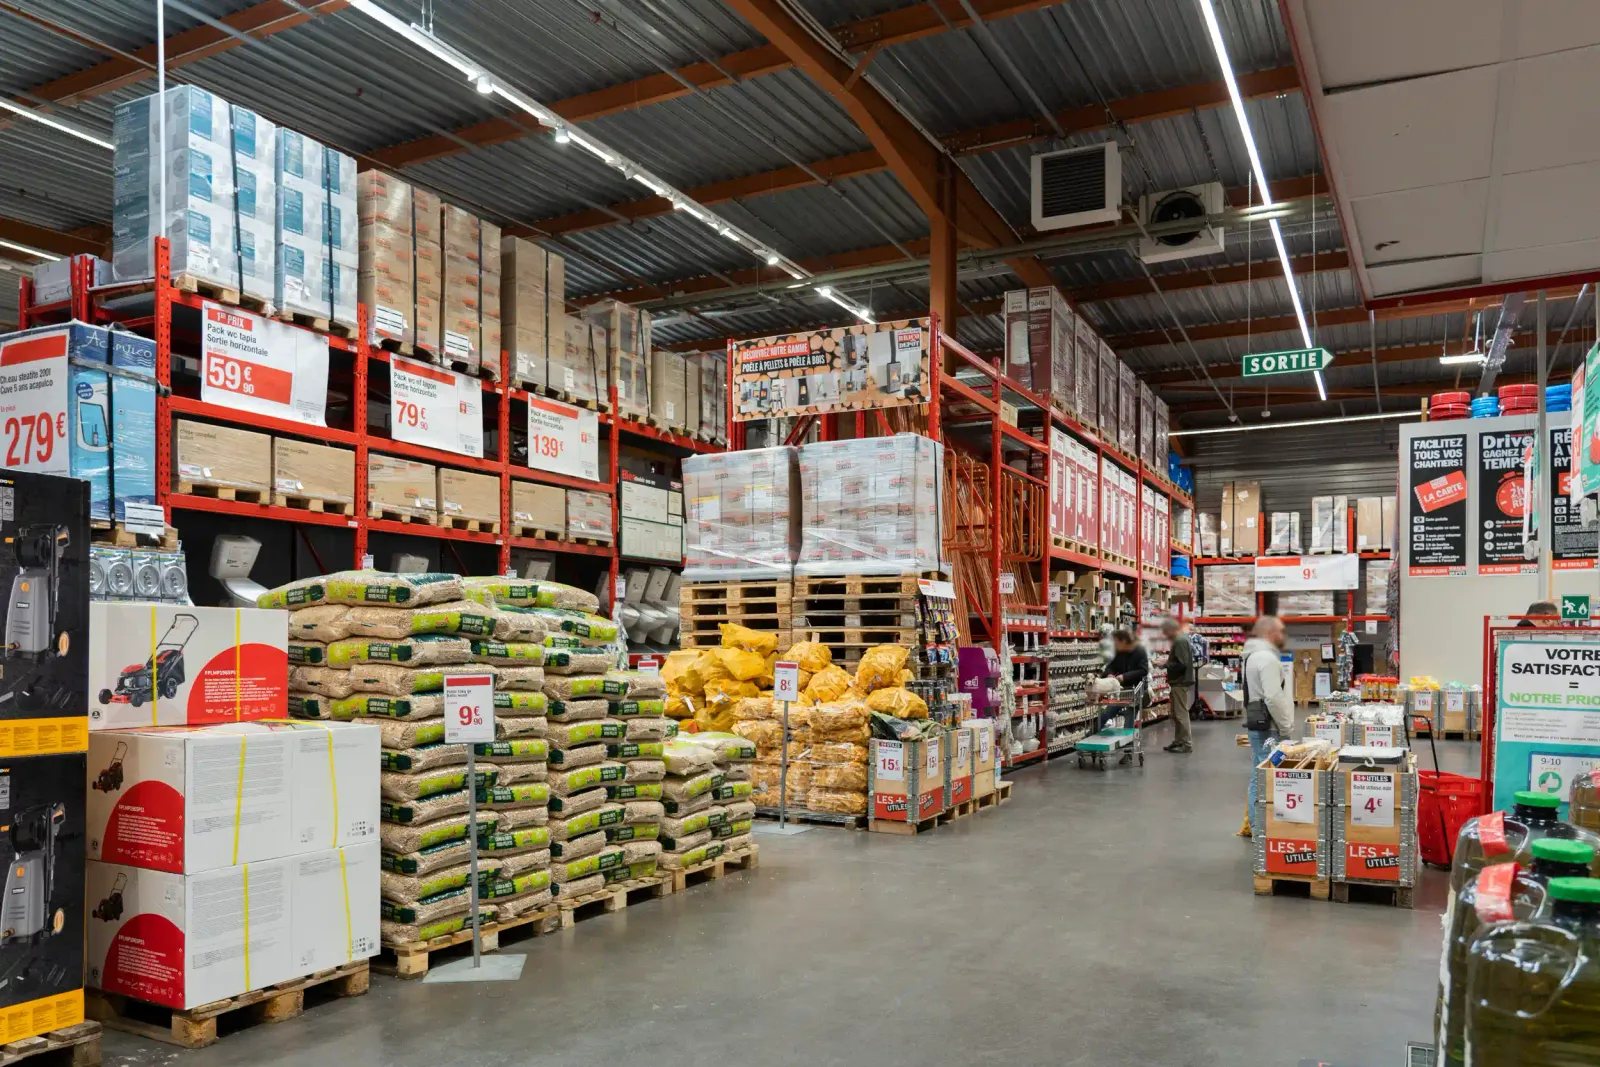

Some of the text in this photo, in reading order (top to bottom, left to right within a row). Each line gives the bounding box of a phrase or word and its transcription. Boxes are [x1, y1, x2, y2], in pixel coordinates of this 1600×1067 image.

[227, 314, 244, 329] PRIX
[207, 323, 257, 344] Pack wc tapia
[207, 334, 269, 357] Sortie horizontale
[743, 343, 808, 360] DÉCOUVREZ NOTRE GAMME
[742, 354, 825, 372] POÊLE À PELLETS & POÊLE À BOIS
[1250, 352, 1317, 373] SORTIE
[394, 372, 406, 381] Pack
[0, 379, 54, 394] Cuve 5 ans acapulco
[394, 381, 438, 399] Sortie horizontale
[1413, 438, 1463, 450] FACILITEZ
[1483, 434, 1534, 450] Drive
[1414, 448, 1463, 461] TOUS VOS
[1483, 448, 1519, 458] GAGNEZ
[1554, 444, 1564, 457] À
[1423, 482, 1464, 503] LA CARTE
[1545, 648, 1600, 662] VOTRE
[1509, 692, 1562, 705] NOTRE
[1541, 757, 1561, 766] 9-10
[876, 795, 904, 804] LES +
[1269, 840, 1311, 853] LES +
[1350, 845, 1394, 858] LES +
[1285, 852, 1317, 863] UTILES
[1366, 856, 1400, 868] UTILES
